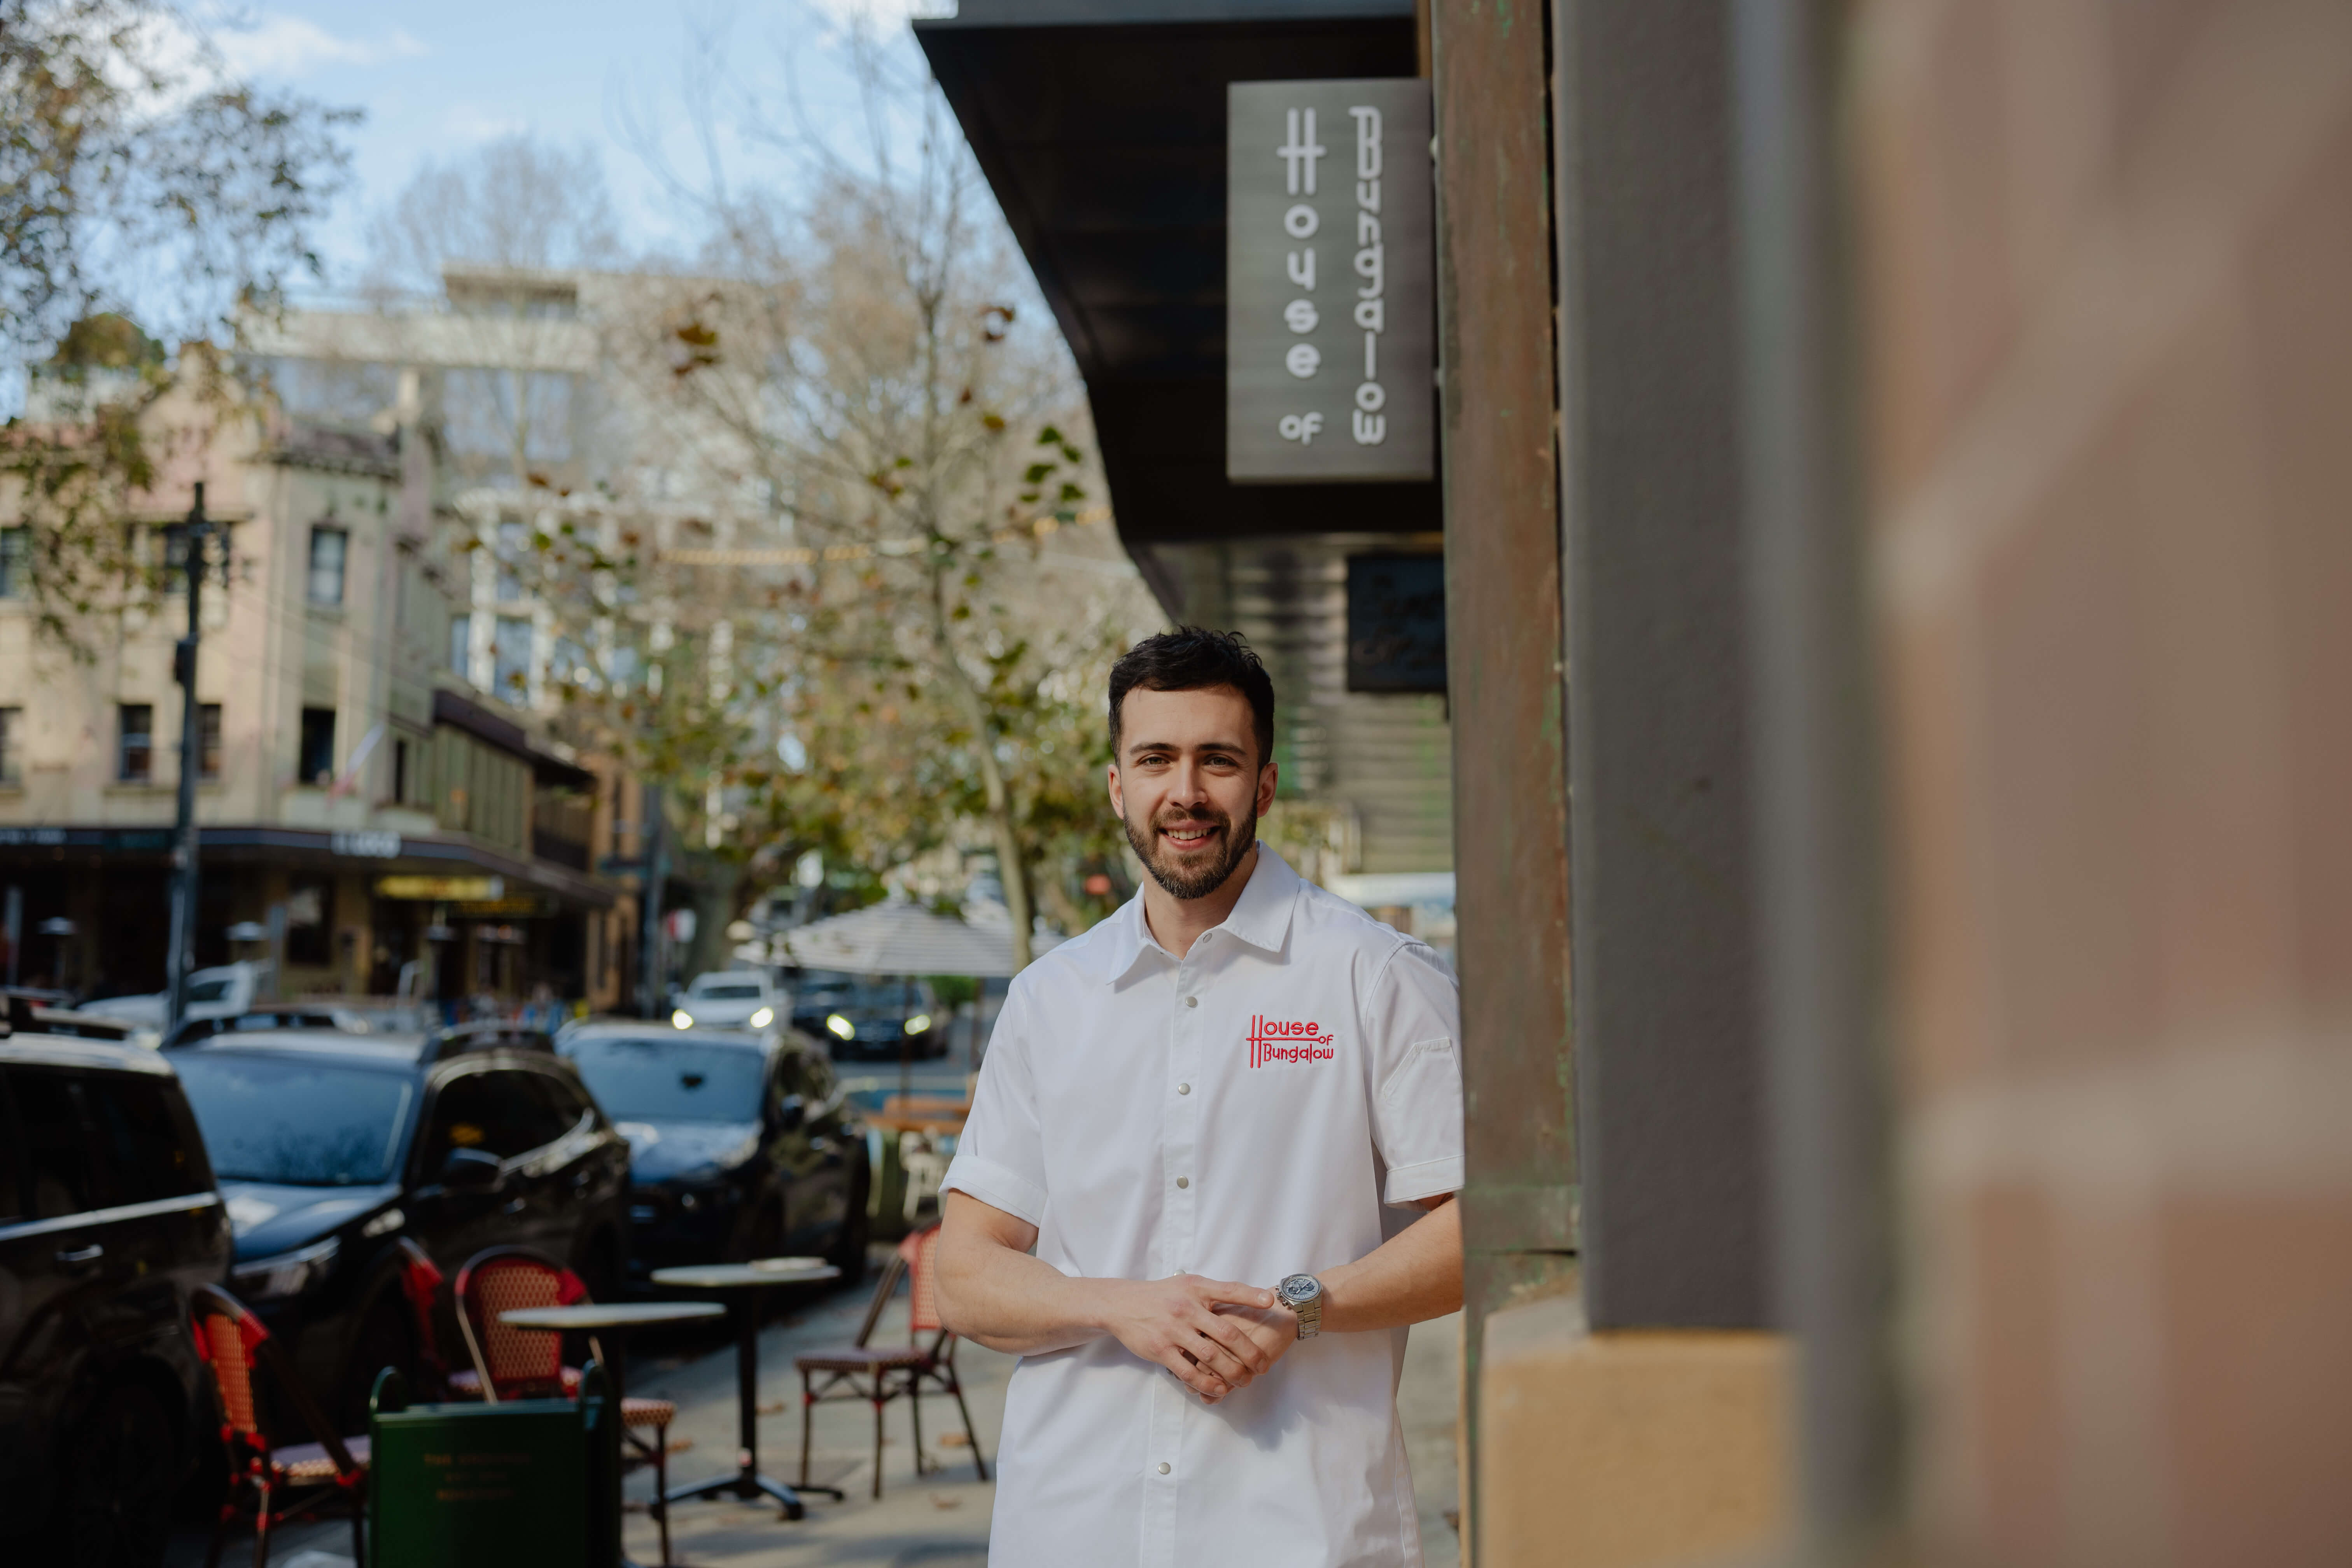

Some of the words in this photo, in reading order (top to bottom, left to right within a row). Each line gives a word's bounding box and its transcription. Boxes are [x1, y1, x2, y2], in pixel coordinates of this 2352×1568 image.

[1276, 107, 1327, 378] House
[1348, 105, 1386, 445] Bungalow
[1278, 411, 1323, 446] of
[1246, 1014, 1319, 1069] House
[1318, 1034, 1334, 1045] of
[1263, 1043, 1334, 1064] Bungalow
